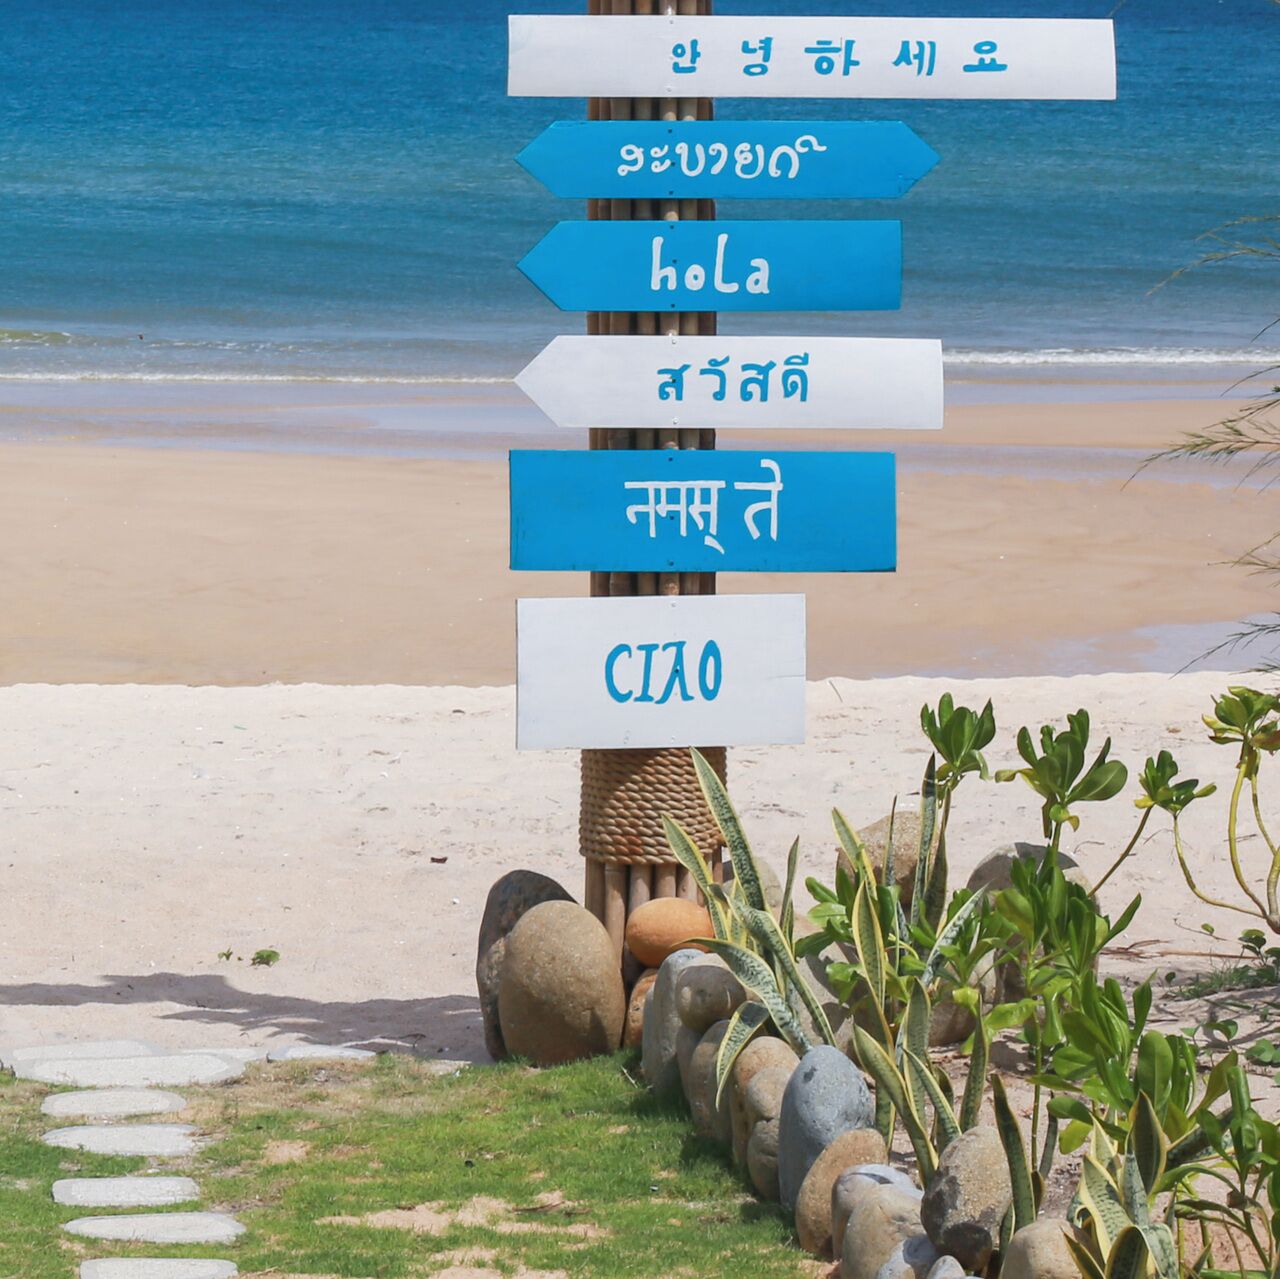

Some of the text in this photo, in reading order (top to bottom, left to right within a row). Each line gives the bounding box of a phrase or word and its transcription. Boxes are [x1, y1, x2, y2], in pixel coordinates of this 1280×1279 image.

[671, 36, 1008, 77] 안녕하세요
[657, 352, 810, 403] สวัสดี
